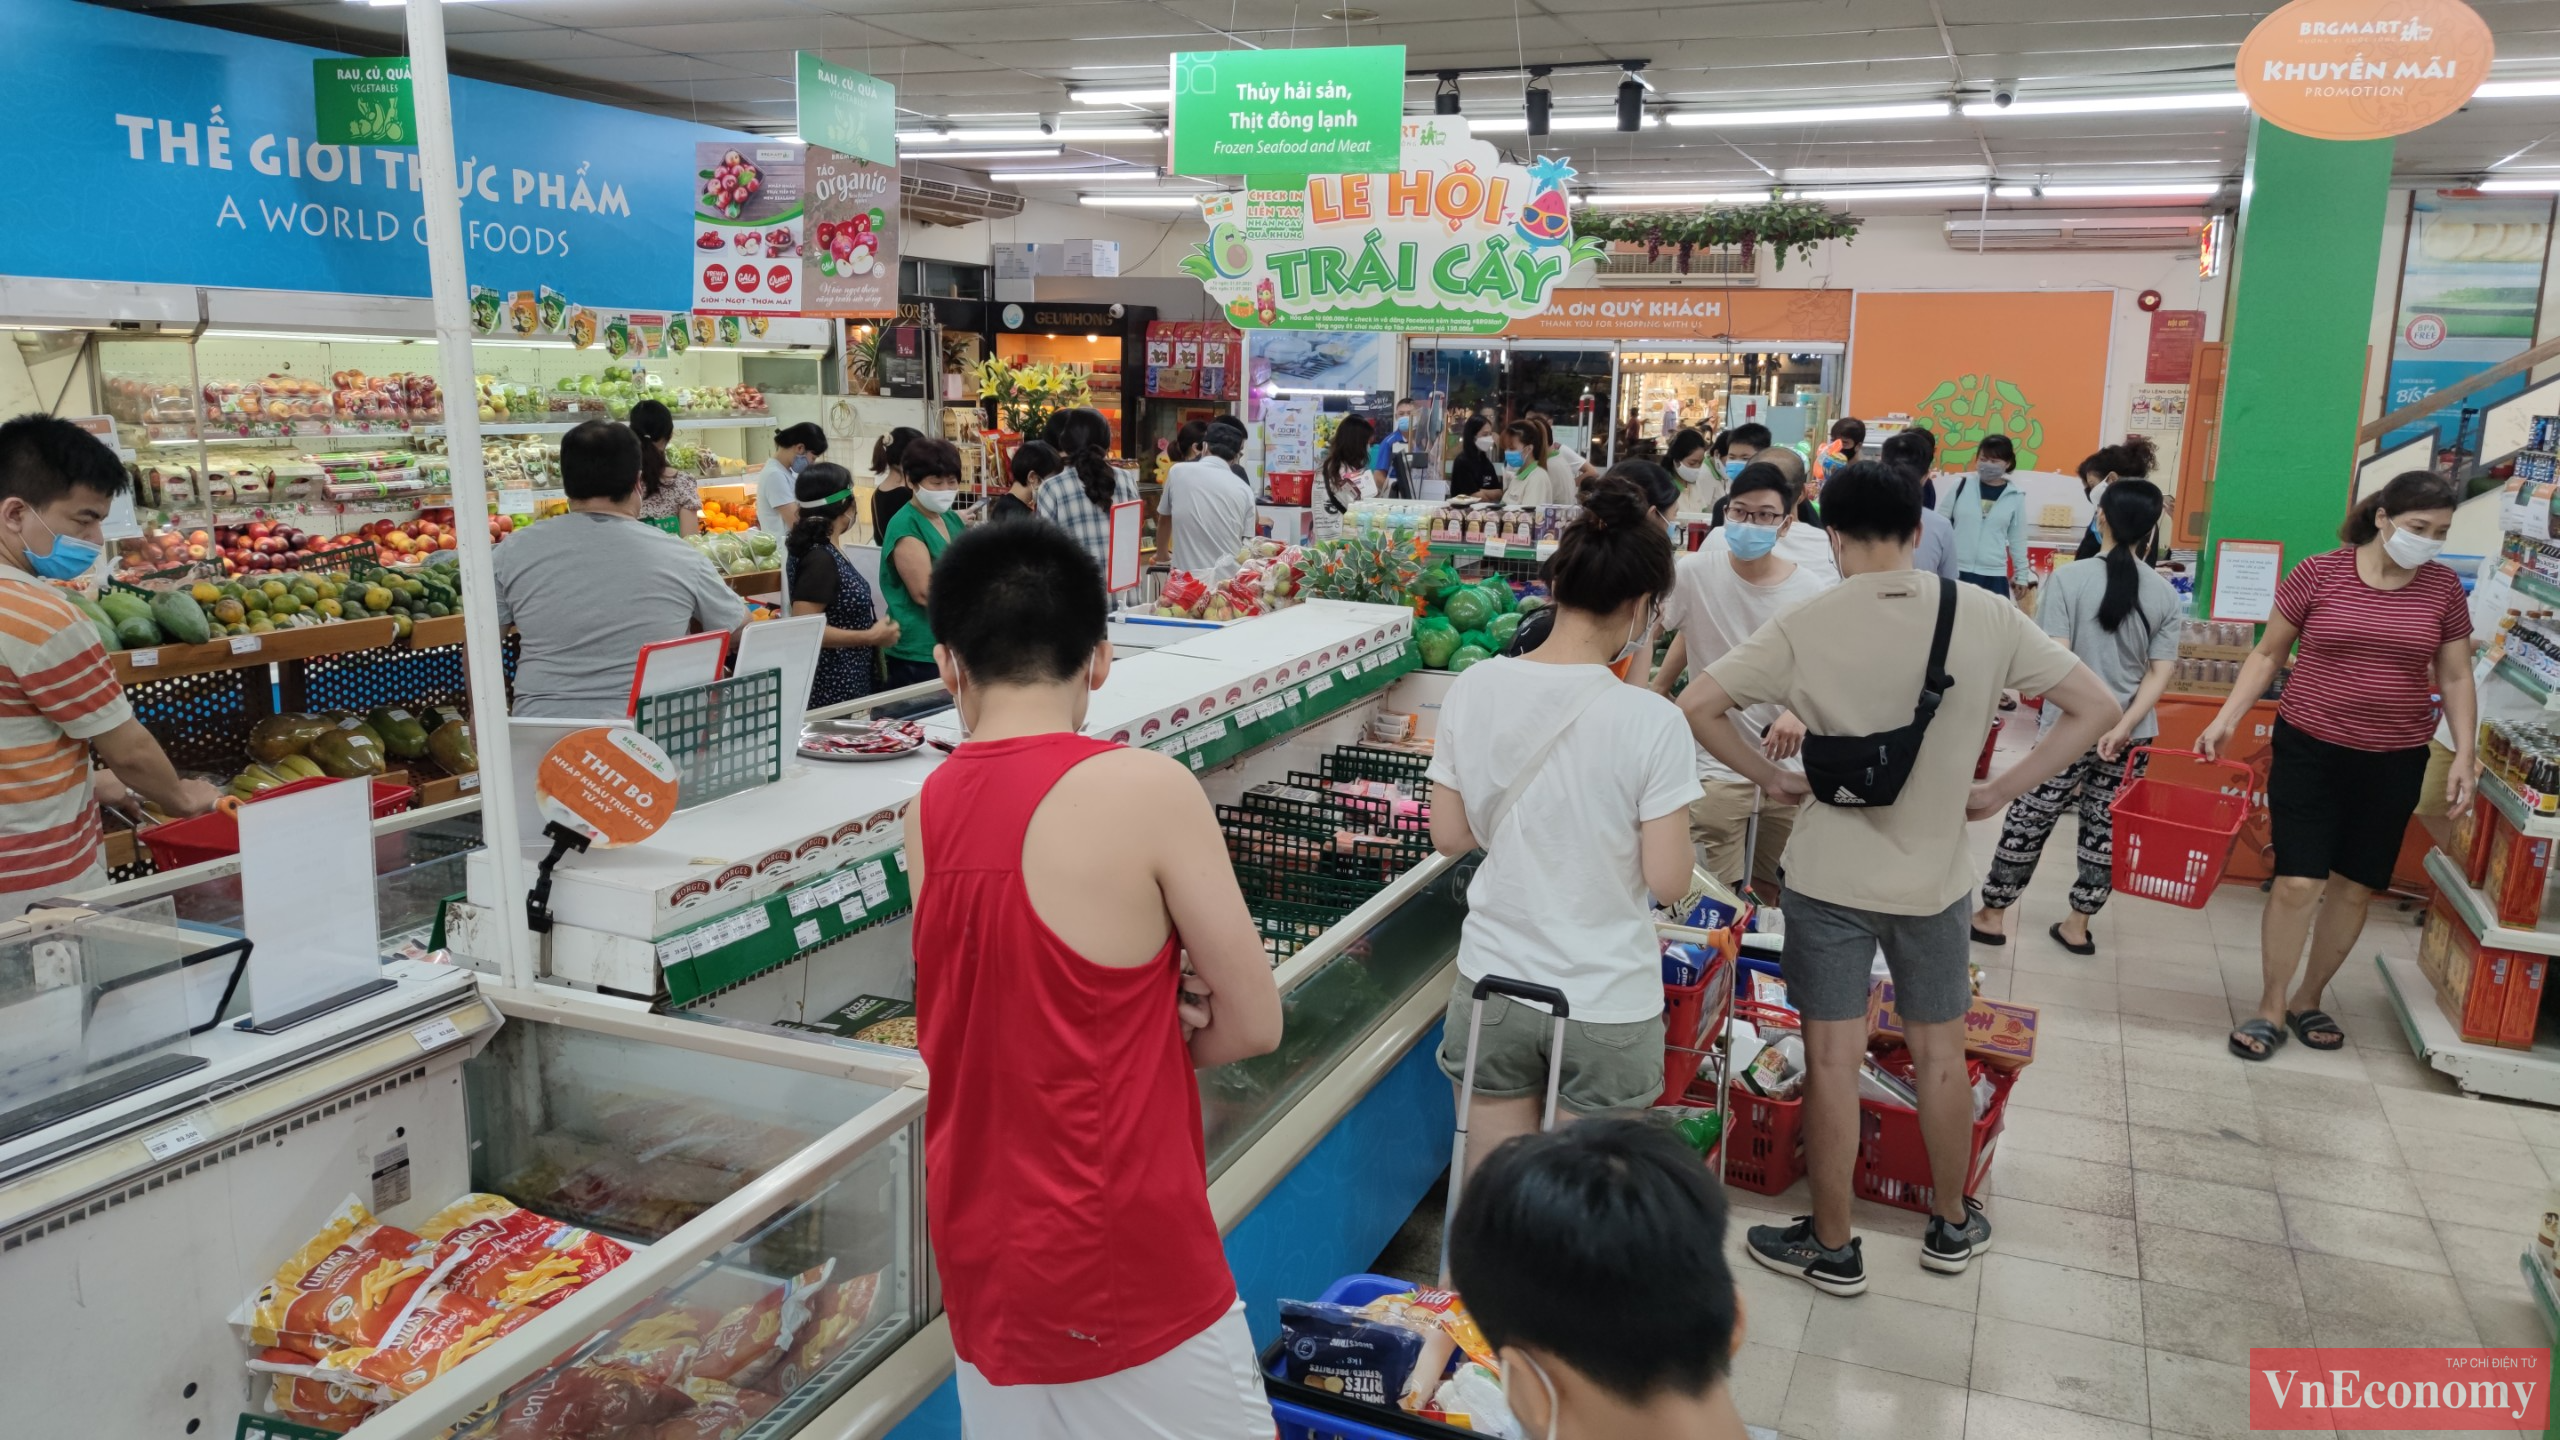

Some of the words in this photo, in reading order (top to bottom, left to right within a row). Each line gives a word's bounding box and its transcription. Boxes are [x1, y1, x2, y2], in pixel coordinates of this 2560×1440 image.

[2299, 20, 2402, 36] BRGMART
[336, 68, 363, 81] RAU,
[365, 65, 383, 81] CỦ,
[386, 64, 412, 80] QUẢ
[2262, 52, 2386, 81] KHUYẾN
[2392, 55, 2457, 79] MÃI
[350, 83, 399, 93] VEGETABLES
[1235, 81, 1280, 104] Thủy
[1284, 80, 1311, 100] hải
[1315, 79, 1352, 101] sản,
[2304, 86, 2405, 97] PROMOTION
[1229, 112, 1263, 134] Thịt
[1267, 110, 1314, 132] đông
[1318, 109, 1358, 132] lạnh
[1213, 141, 1254, 154] Frozen
[1256, 139, 1308, 154] Seafood
[1309, 139, 1335, 153] and
[1337, 139, 1371, 153] Meat
[115, 104, 233, 171] THẾ
[512, 160, 631, 218] PHẨM
[816, 164, 835, 177] TÁO
[816, 169, 887, 202] organic
[1248, 191, 1288, 201] CHECK
[1290, 191, 1303, 201] IN
[1387, 160, 1510, 233] HỘI
[216, 194, 247, 230] A
[258, 198, 400, 242] WORLD
[469, 220, 569, 257] FOODS
[1265, 227, 1417, 300] TRÁI
[1432, 233, 1562, 304] CÂY
[1600, 298, 1642, 317] QUÝ
[1648, 298, 1721, 317] KHÁCH
[1034, 311, 1113, 326] GEUMHONG
[1540, 319, 1572, 328] THANK
[1574, 320, 1593, 328] YOU
[1595, 320, 1613, 328] FOR
[1615, 320, 1661, 328] SHOPPING
[1663, 320, 1688, 328] WITH
[1691, 321, 1704, 329] US
[2417, 324, 2436, 332] BPA
[2413, 332, 2437, 340] FREE
[621, 735, 657, 764] BRGMART
[580, 749, 628, 788] THỊT
[623, 783, 655, 809] BÒ
[551, 755, 582, 777] NHẬP
[609, 796, 633, 818] TRỰC
[633, 813, 655, 832] TIẾP
[760, 851, 789, 868] BORGES
[719, 866, 749, 884] BORGES
[675, 882, 707, 901] BORGES
[447, 1222, 496, 1245] TOSA
[303, 1250, 354, 1287] LUTOSA
